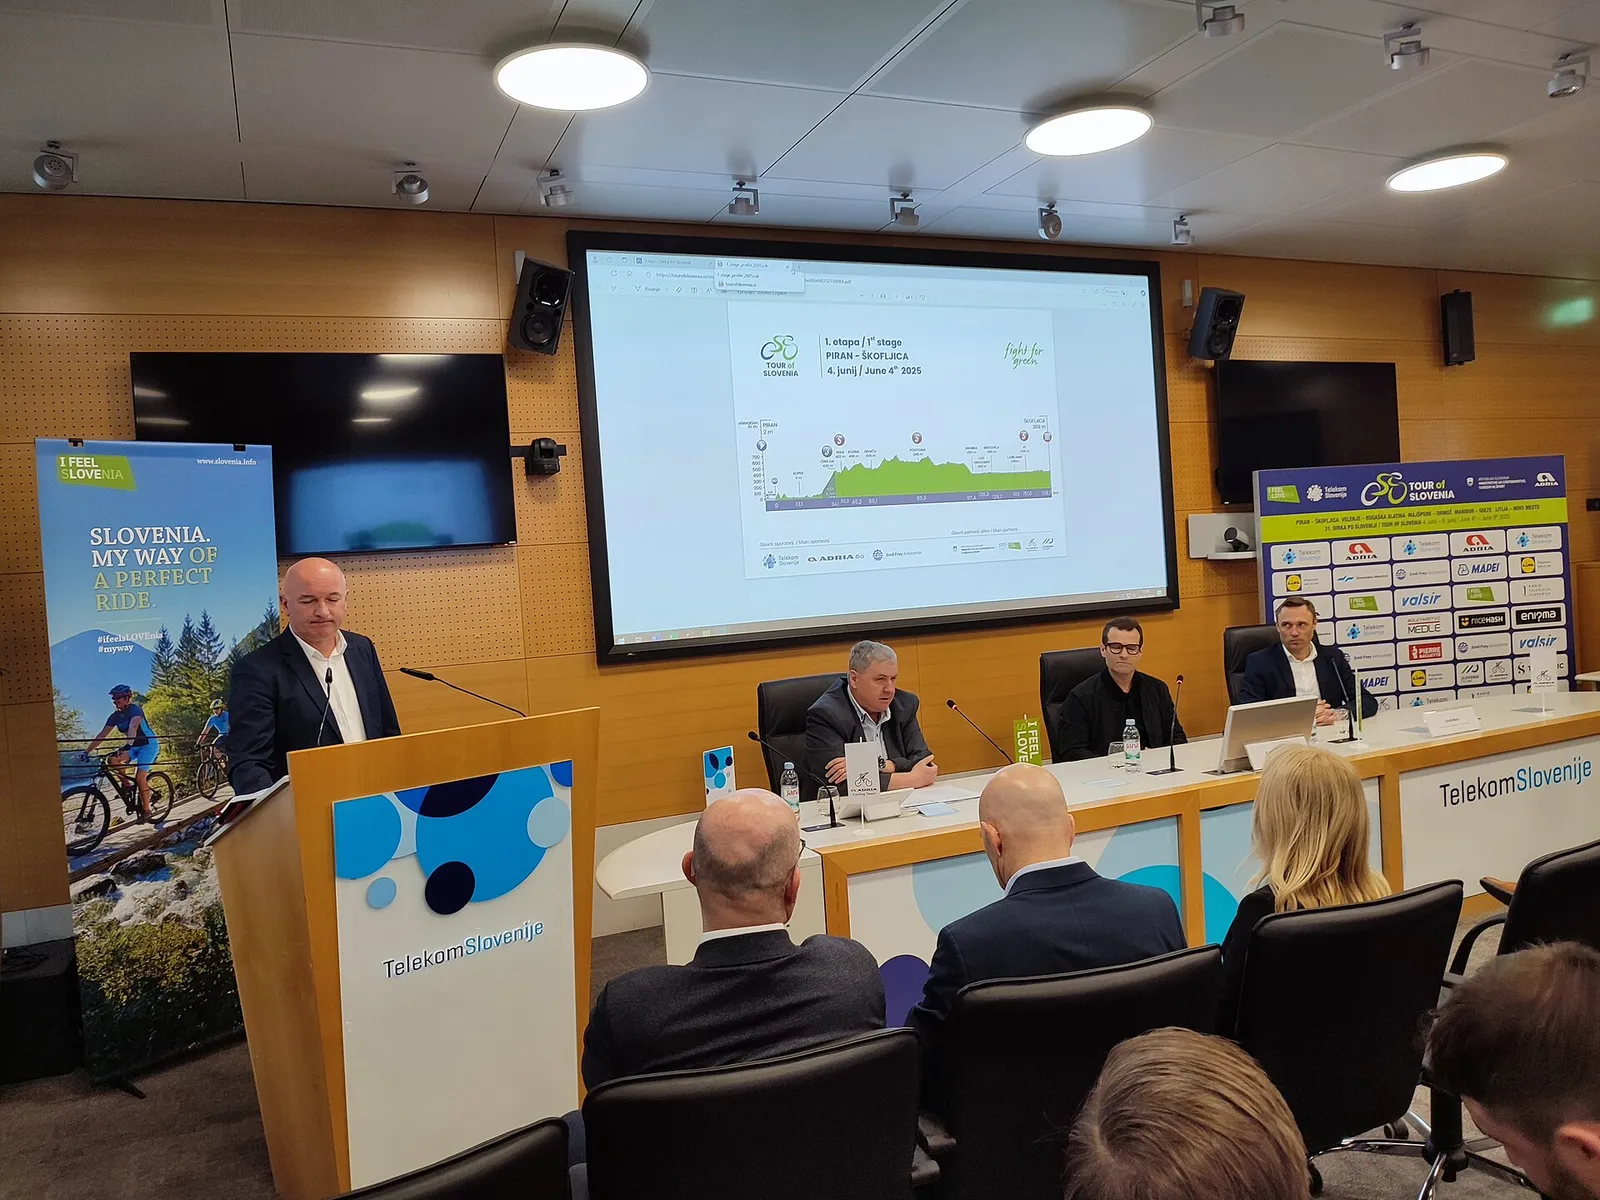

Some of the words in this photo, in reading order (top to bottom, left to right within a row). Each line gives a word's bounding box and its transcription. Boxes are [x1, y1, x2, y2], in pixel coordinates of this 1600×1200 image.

[833, 338, 860, 348] etapa
[877, 338, 903, 349] stage
[826, 351, 853, 360] PIRAN
[861, 349, 909, 360] ŠKOFLJICA
[1004, 341, 1028, 360] fight
[1030, 342, 1044, 359] for
[1013, 358, 1039, 370] green
[827, 366, 836, 375] 4.
[837, 366, 857, 377] junij
[864, 366, 887, 375] June
[901, 366, 922, 375] 2025
[60, 457, 66, 468] I
[68, 457, 99, 468] FEEL
[196, 457, 257, 466] www.slovenia.info
[61, 469, 124, 480] SLOVENIA
[1408, 480, 1434, 491] TOUR
[1435, 480, 1446, 489] of
[1409, 490, 1455, 501] SLOVENIA
[89, 526, 212, 546] SLOVENIA.
[91, 549, 131, 567] MY
[133, 547, 184, 566] WAY
[189, 546, 218, 564] OF
[819, 554, 854, 562] ADRIA
[1471, 562, 1500, 574] MAPEI
[92, 572, 110, 590] A
[115, 567, 213, 589] PERFECT
[95, 591, 157, 612] RIDE.
[1401, 591, 1442, 607] valsir
[1408, 623, 1441, 635] MEDLE
[97, 631, 164, 644] #ifeelsLOVEnia
[1520, 634, 1557, 649] valsir
[98, 643, 134, 654] #myway
[1360, 676, 1390, 688] MAPEI
[1426, 696, 1448, 704] Telekom
[1028, 729, 1039, 760] FEEL
